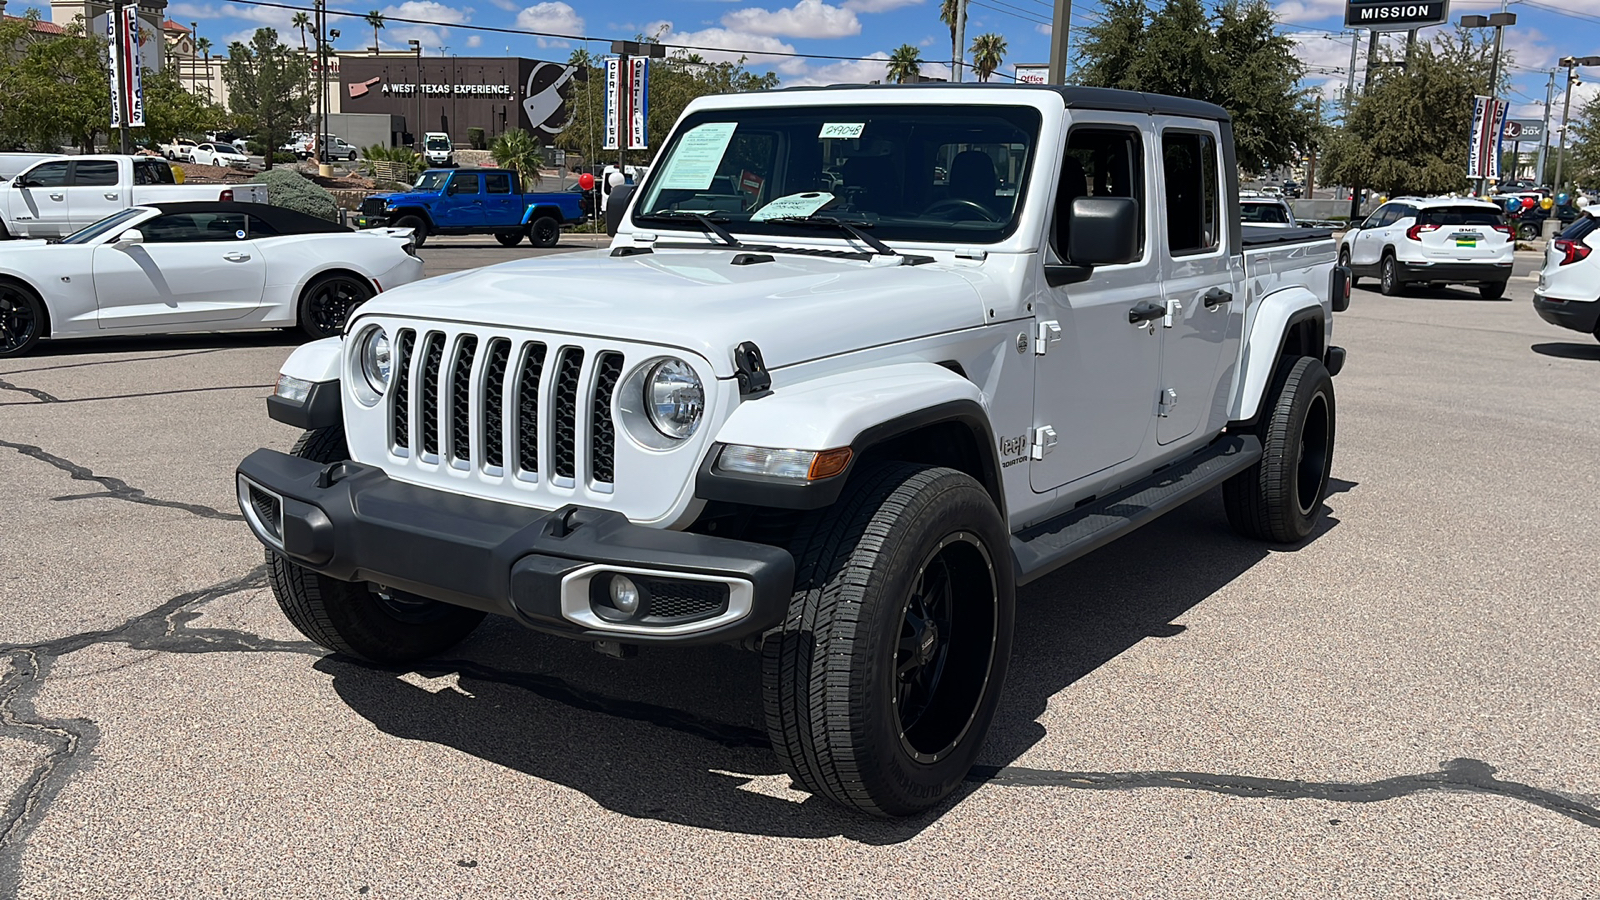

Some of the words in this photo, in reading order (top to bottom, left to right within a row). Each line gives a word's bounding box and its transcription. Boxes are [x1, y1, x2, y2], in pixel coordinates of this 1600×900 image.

[1360, 5, 1429, 19] MISSION
[381, 84, 389, 93] A
[391, 84, 416, 93] WEST
[420, 84, 450, 94] TEXAS
[608, 62, 616, 144] CERTIFIED
[633, 60, 642, 144] CERTIFIED
[1475, 100, 1483, 122] LOW
[1495, 103, 1503, 125] LOW
[1521, 127, 1541, 135] box
